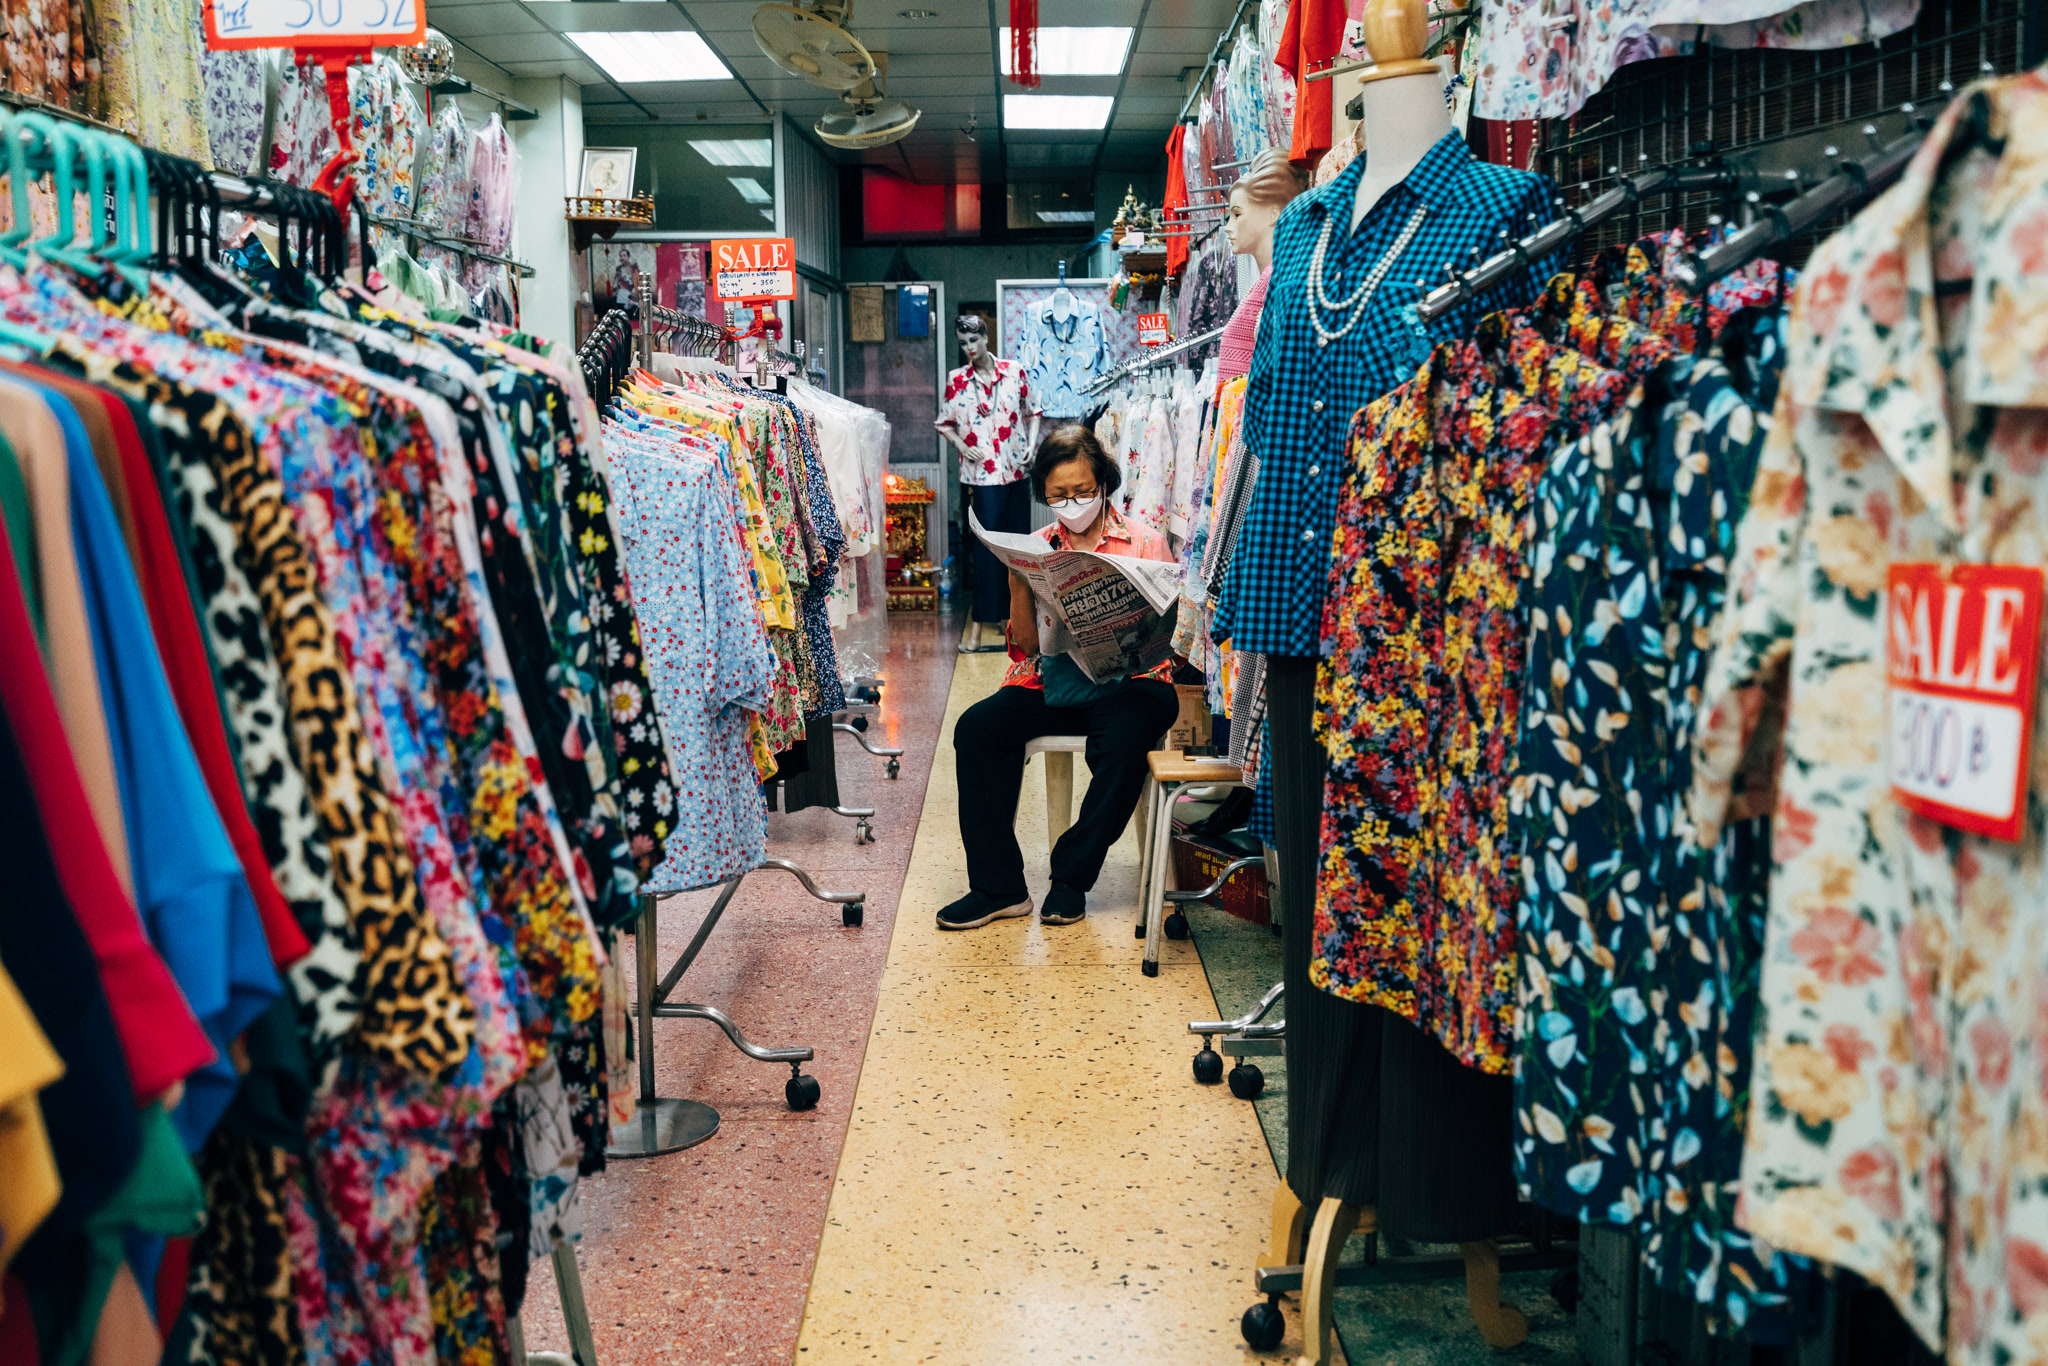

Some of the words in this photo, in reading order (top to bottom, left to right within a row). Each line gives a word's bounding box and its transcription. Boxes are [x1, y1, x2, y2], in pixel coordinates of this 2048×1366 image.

[718, 243, 789, 270] SALE
[1140, 315, 1166, 330] SALE
[1888, 582, 2024, 695] SALE
[1194, 850, 1212, 861] pear
